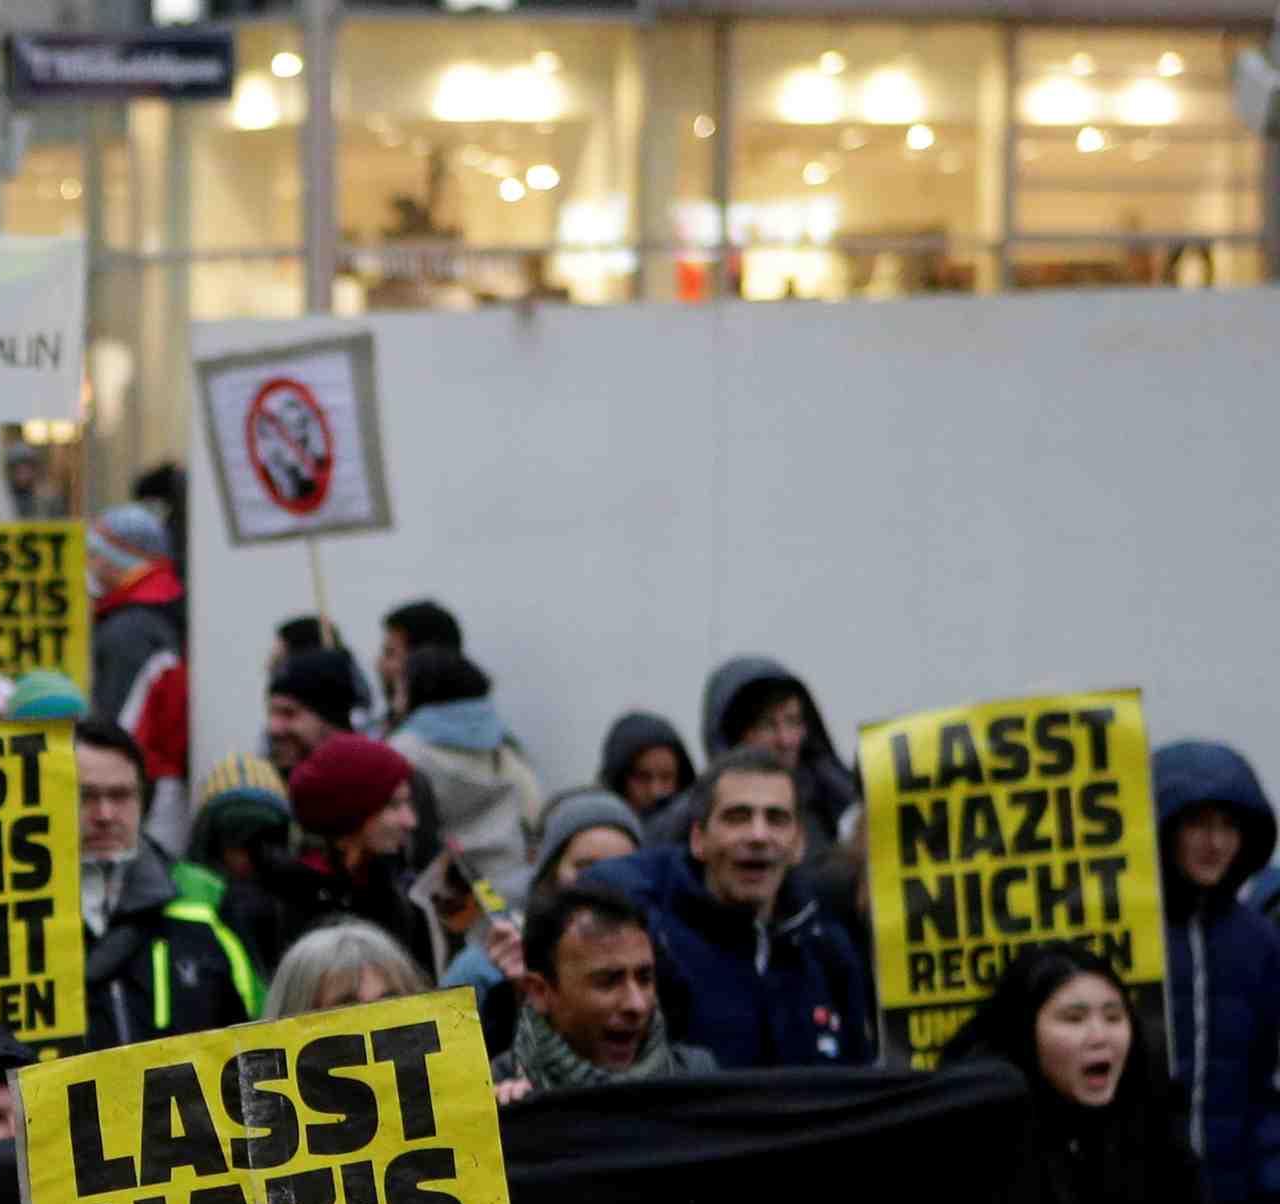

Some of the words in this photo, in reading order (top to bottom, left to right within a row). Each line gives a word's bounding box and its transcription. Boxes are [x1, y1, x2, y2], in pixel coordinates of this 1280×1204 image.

[890, 707, 1116, 794] LASST
[896, 781, 1125, 869] NAZIS
[900, 856, 1130, 944] NICHT
[65, 1019, 442, 1199] LASST
